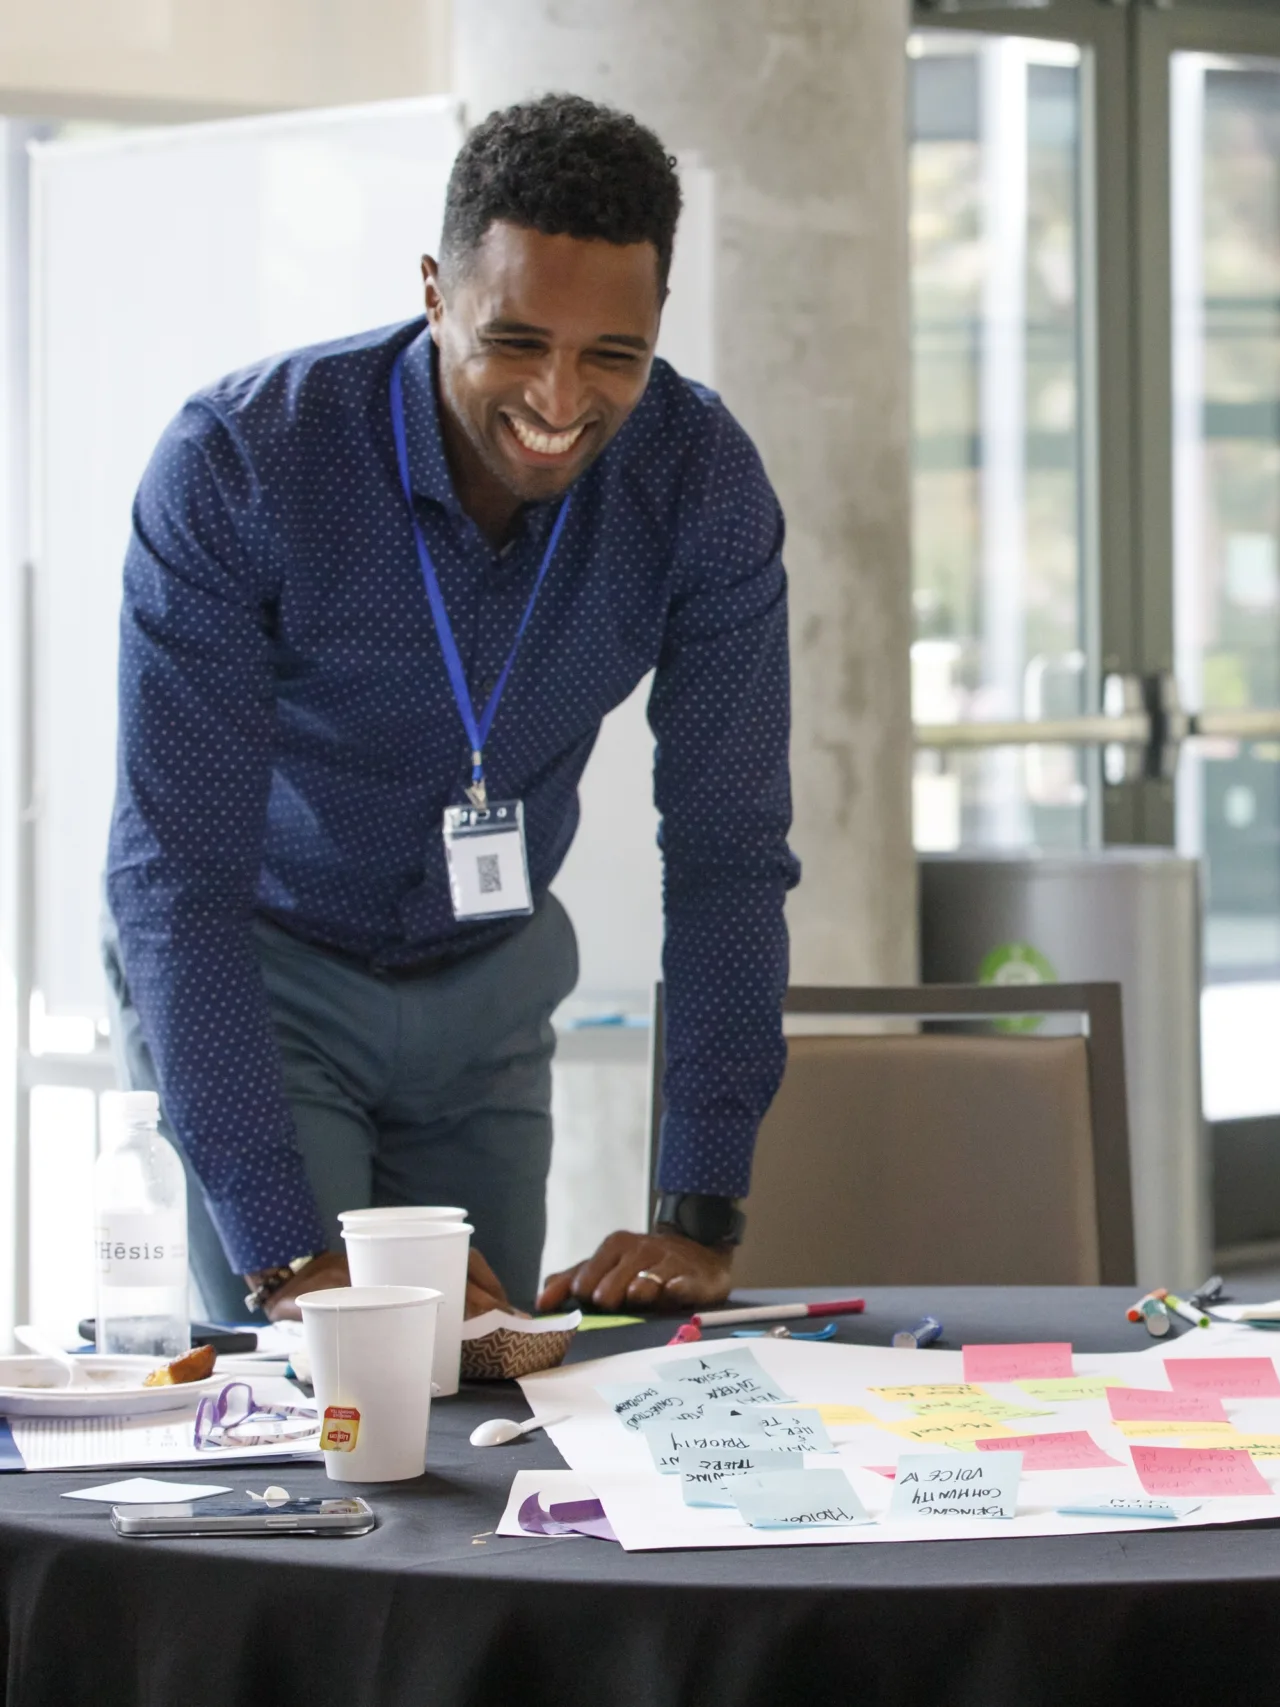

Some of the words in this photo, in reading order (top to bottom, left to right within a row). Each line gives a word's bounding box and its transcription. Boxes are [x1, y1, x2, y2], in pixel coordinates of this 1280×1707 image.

[95, 1241, 165, 1260] Hēsis
[329, 1433, 349, 1441] Lipon
[923, 1467, 984, 1483] VOICE
[911, 1487, 1002, 1505] COMMUNITY
[918, 1505, 1008, 1518] BRINGING
